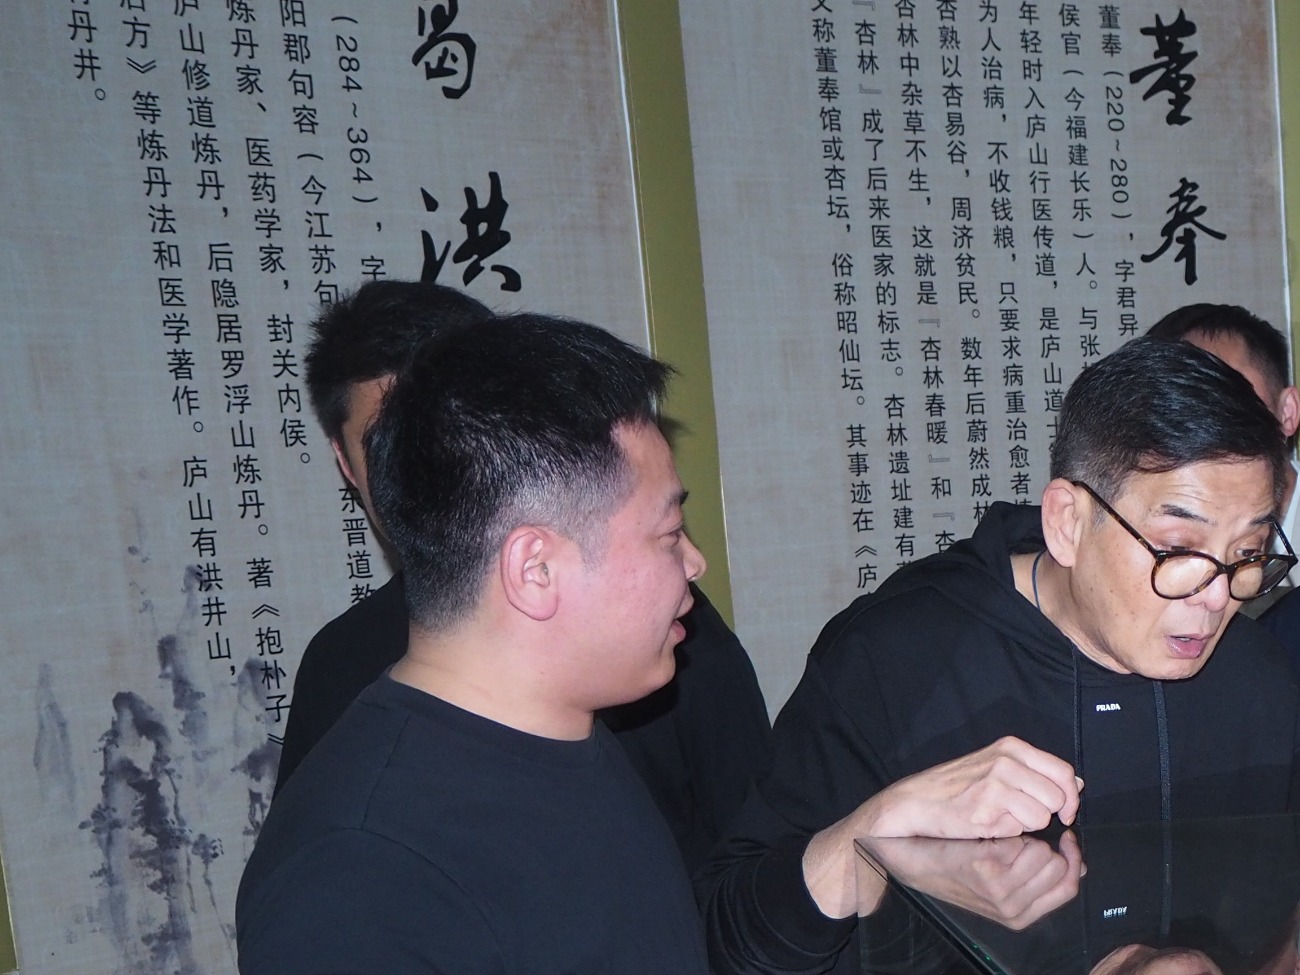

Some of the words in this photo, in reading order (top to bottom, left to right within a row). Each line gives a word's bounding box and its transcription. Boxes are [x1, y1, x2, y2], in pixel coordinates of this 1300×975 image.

[66, 0, 106, 101] 丹井。
[978, 1, 1034, 506] 为人治病，不收钱粮，只要求病重治愈者
[1019, 1, 1067, 452] 年轻时入庐山行医传道，是庐山道士
[1058, 2, 1102, 374] 侯官（今福建长乐）人。与张
[810, 0, 879, 598] 又称董奉馆或杏坛，俗称昭仙坛。其事迹在《庐
[852, 0, 916, 568] 『杏林』成了后来医家的标志。杏林遗址建有
[1096, 703, 1121, 711] PRADA
